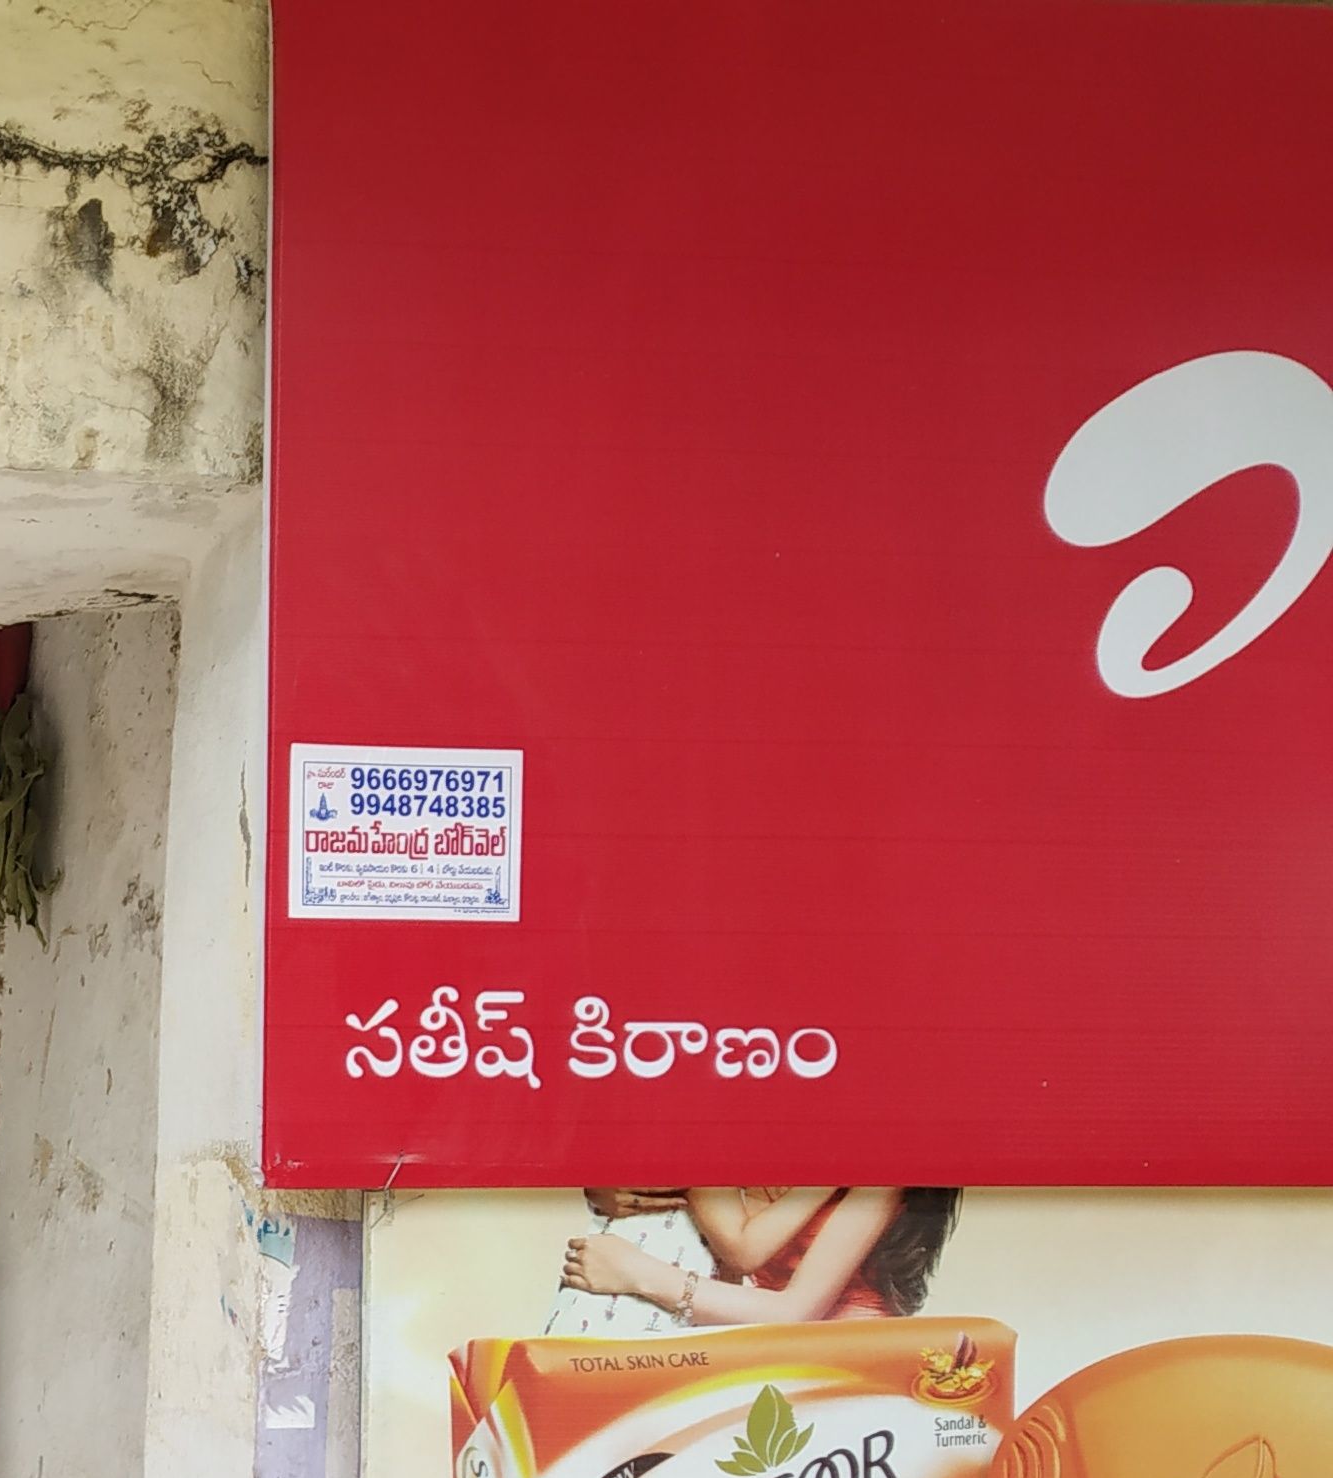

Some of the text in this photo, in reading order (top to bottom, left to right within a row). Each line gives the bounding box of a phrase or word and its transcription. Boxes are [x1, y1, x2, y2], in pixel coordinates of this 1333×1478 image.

[351, 767, 504, 792] 9666976971
[351, 793, 505, 818] 9948748385
[345, 986, 838, 1089] సతీష్ కిరాణం
[570, 1351, 710, 1373] TOTAL SKIN CARE
[934, 1414, 986, 1431] Sandal &
[934, 1430, 987, 1448] Turmeric
